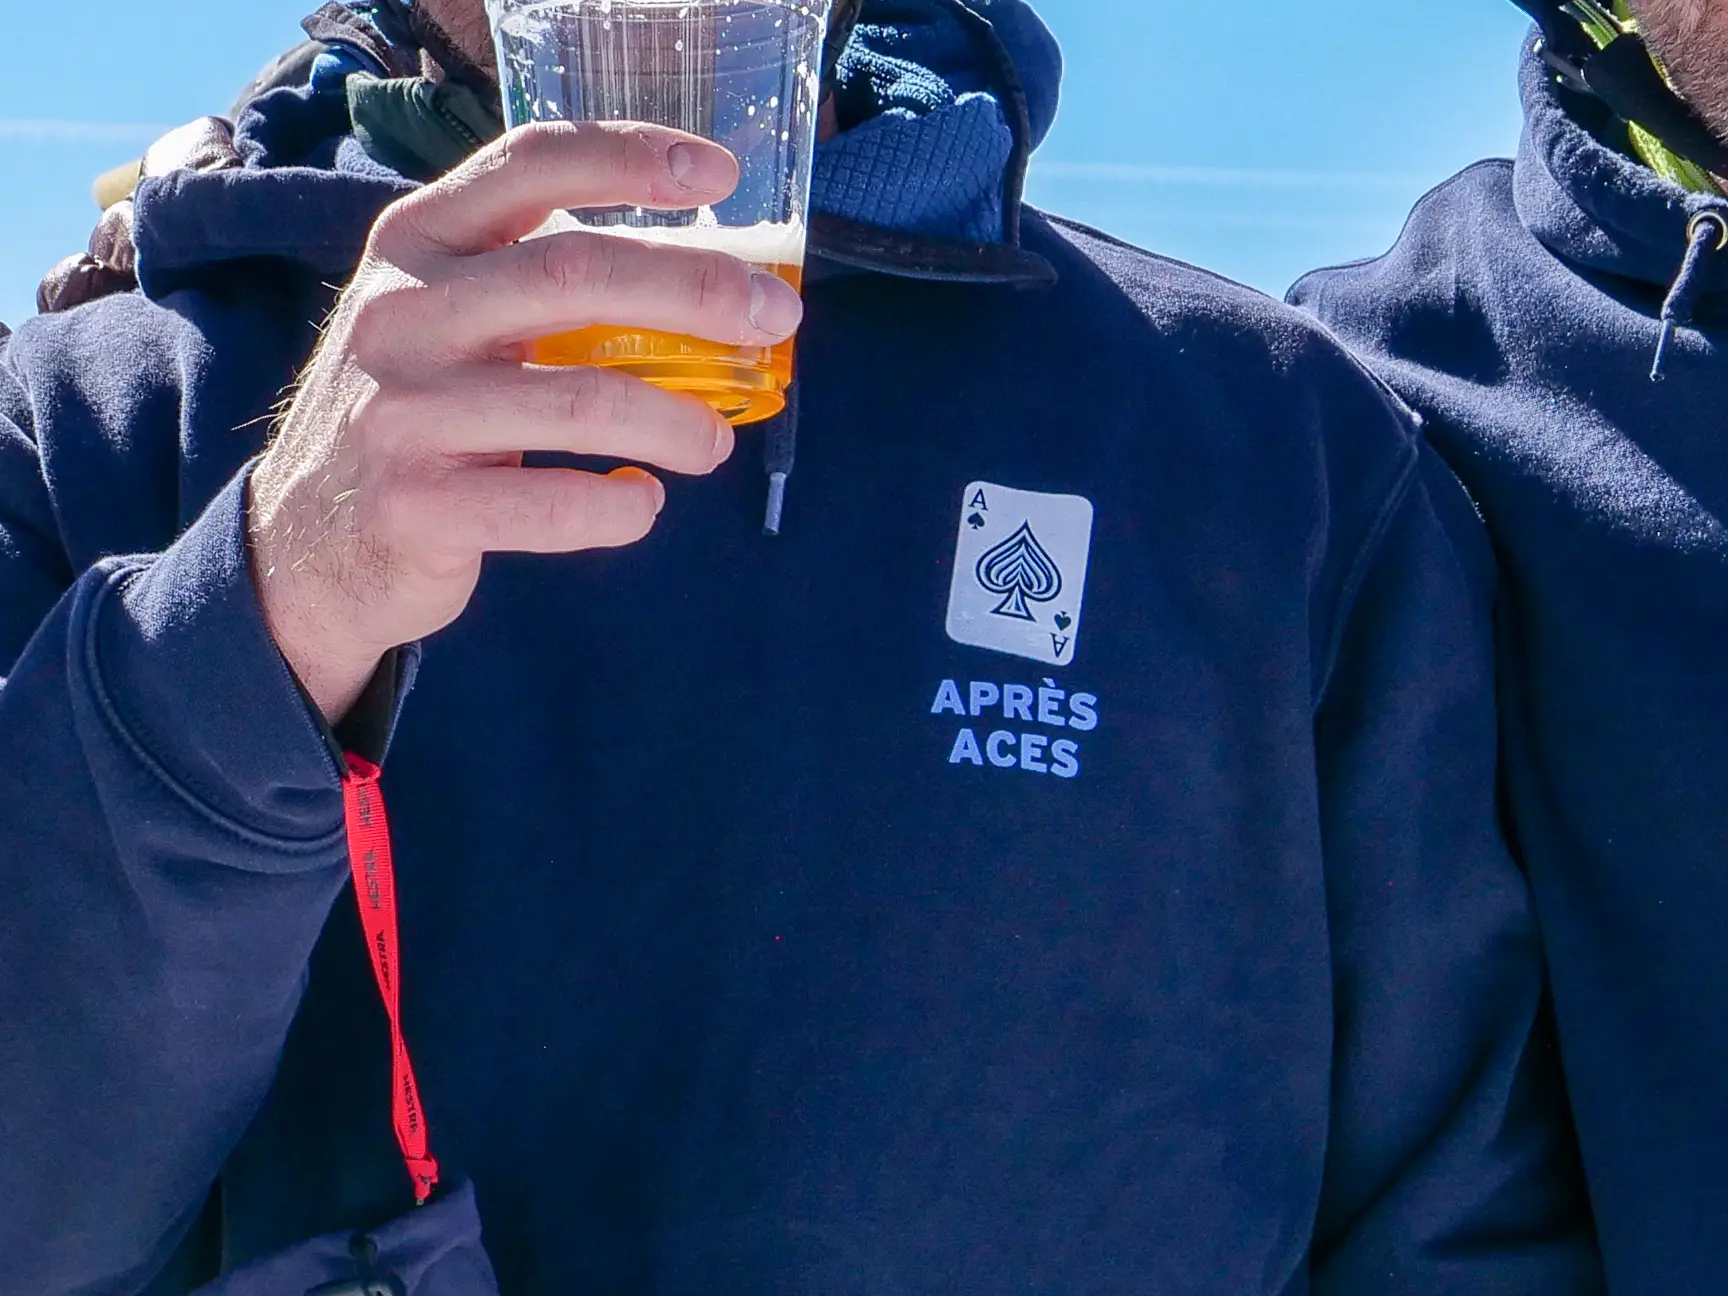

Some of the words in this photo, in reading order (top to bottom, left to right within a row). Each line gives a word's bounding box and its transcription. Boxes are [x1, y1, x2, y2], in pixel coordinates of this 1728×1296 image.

[968, 488, 989, 512] A
[931, 678, 1099, 732] APRÈS
[948, 727, 1081, 780] ACES
